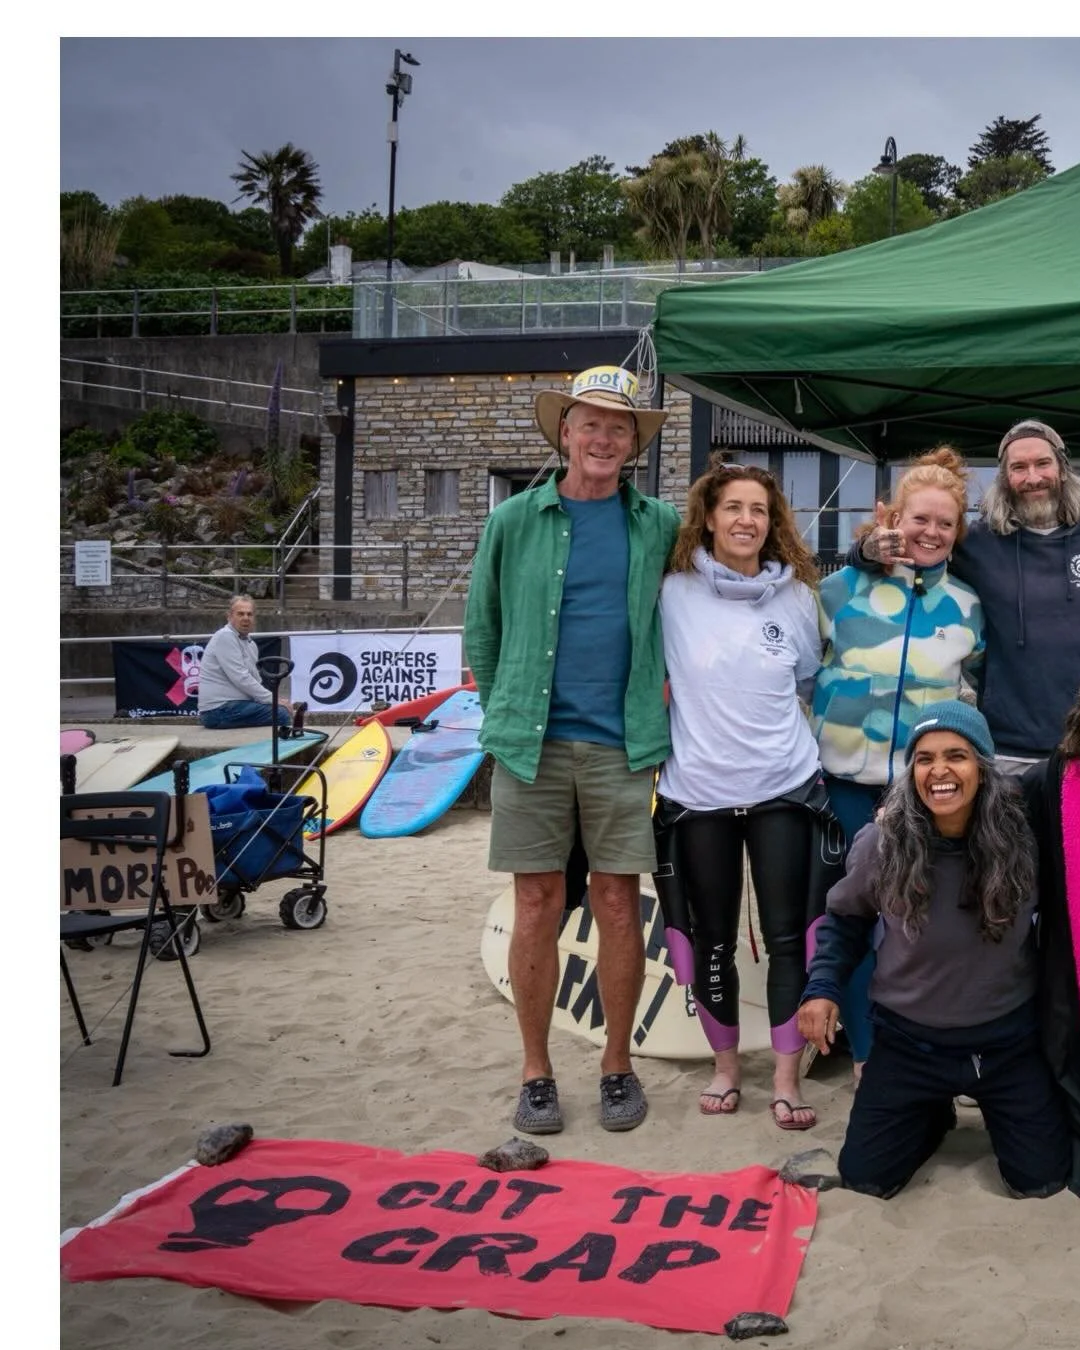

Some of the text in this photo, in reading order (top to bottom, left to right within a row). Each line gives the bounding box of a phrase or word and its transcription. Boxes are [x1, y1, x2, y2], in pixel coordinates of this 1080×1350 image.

[588, 373, 621, 386] not
[361, 651, 436, 667] SURFERS
[361, 666, 437, 685] AGAINST
[377, 1178, 774, 1232] CUT THE
[341, 1228, 721, 1285] CRAP
